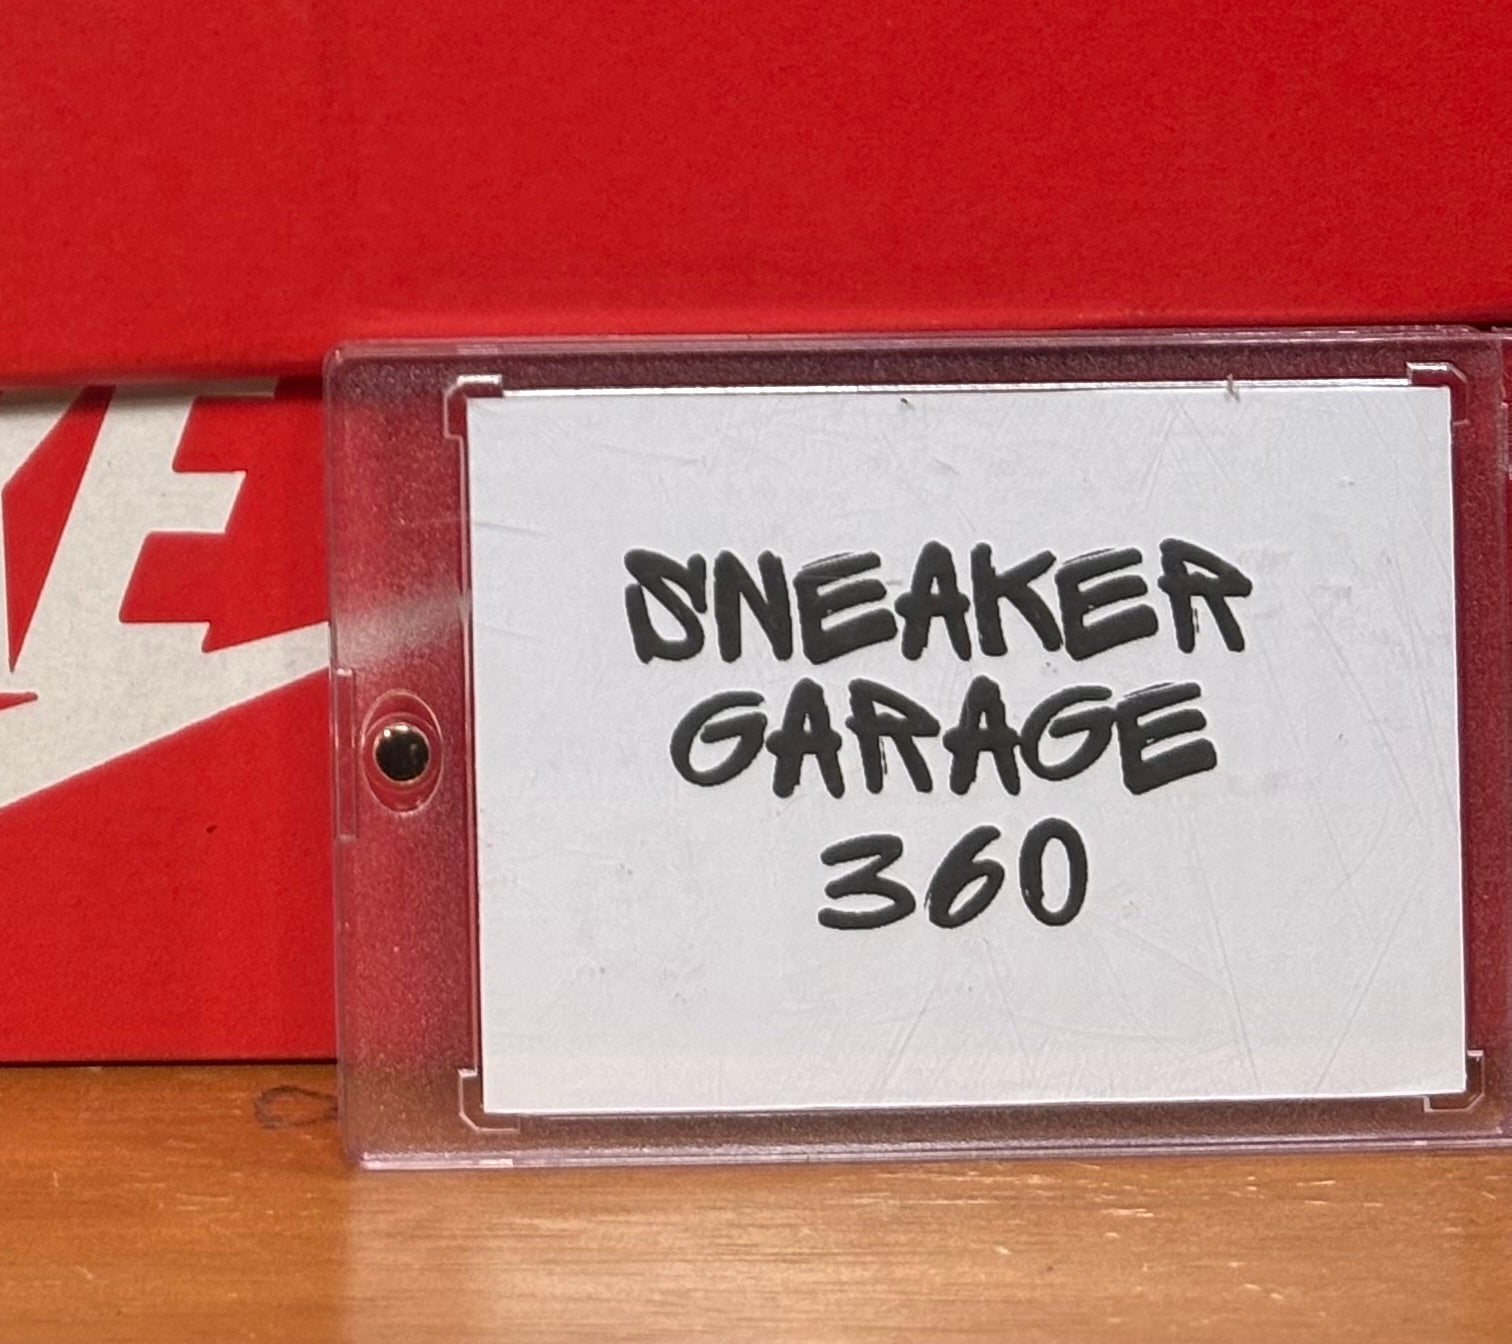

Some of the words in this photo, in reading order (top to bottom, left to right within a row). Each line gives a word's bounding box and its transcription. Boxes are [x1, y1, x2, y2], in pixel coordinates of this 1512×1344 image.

[624, 538, 1253, 664] SNEAKER
[670, 675, 1218, 799] GARAGE
[817, 818, 1088, 930] 360
